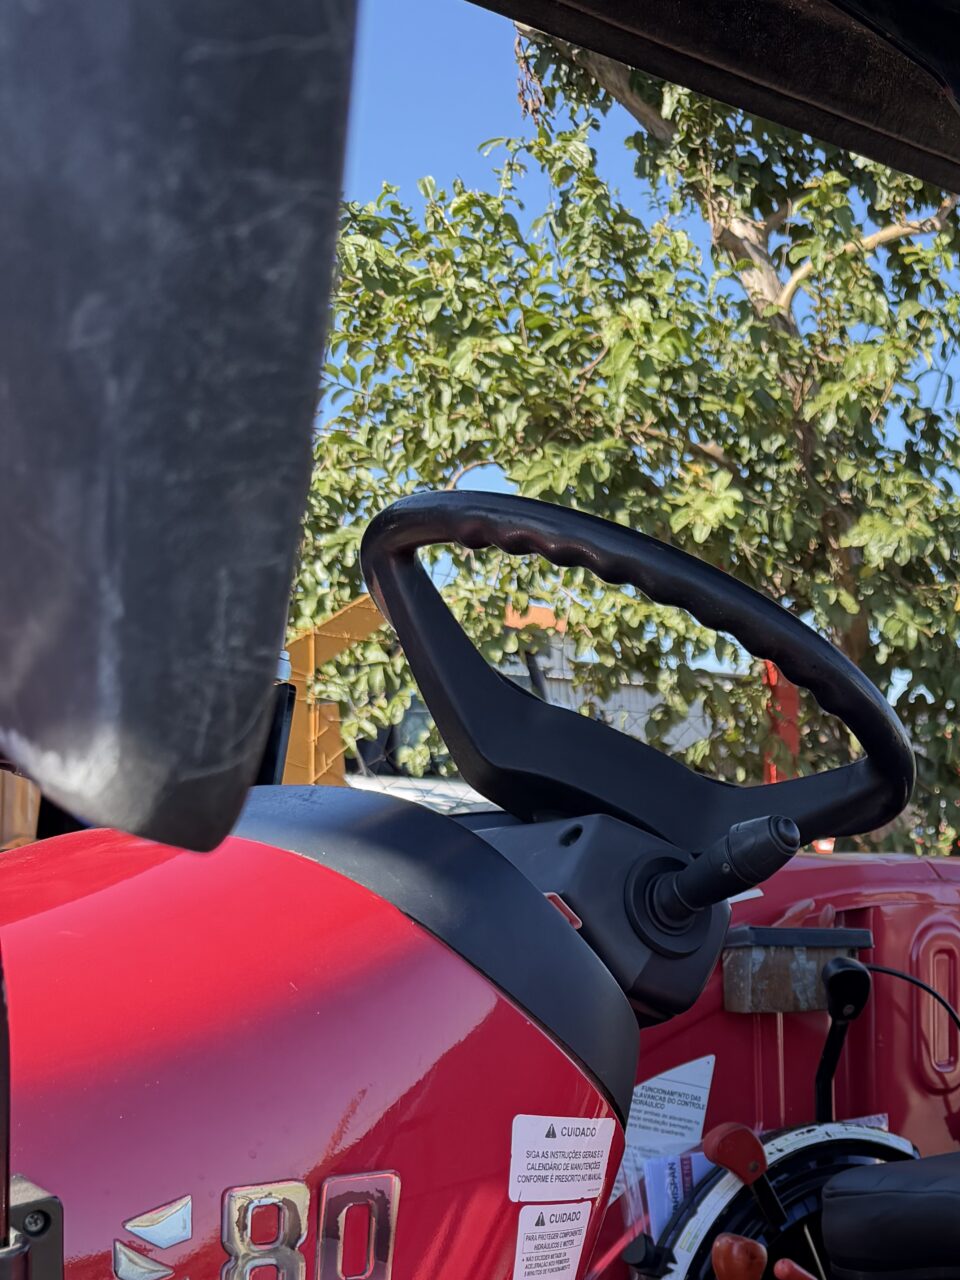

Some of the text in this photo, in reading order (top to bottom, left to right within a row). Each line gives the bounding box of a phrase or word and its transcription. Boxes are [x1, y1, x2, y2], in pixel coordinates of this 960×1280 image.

[690, 1094, 702, 1102] DAS
[667, 1097, 676, 1105] DO
[677, 1098, 706, 1111] CONTROLE
[560, 1126, 597, 1137] CUIDADO
[526, 1150, 540, 1159] SIGA
[541, 1150, 549, 1159] AS
[550, 1149, 581, 1160] INSTRUÇÕES
[582, 1150, 596, 1159] GERAIS
[526, 1161, 601, 1171] CALENDÁRIO DE MANUTENÇÕES
[517, 1174, 549, 1184] CONFORME
[550, 1173, 555, 1183] É
[555, 1174, 581, 1183] PRESCRITO
[549, 1210, 581, 1224] CUIDADO
[526, 1233, 537, 1241] PARA
[538, 1232, 559, 1240] PROTEGER
